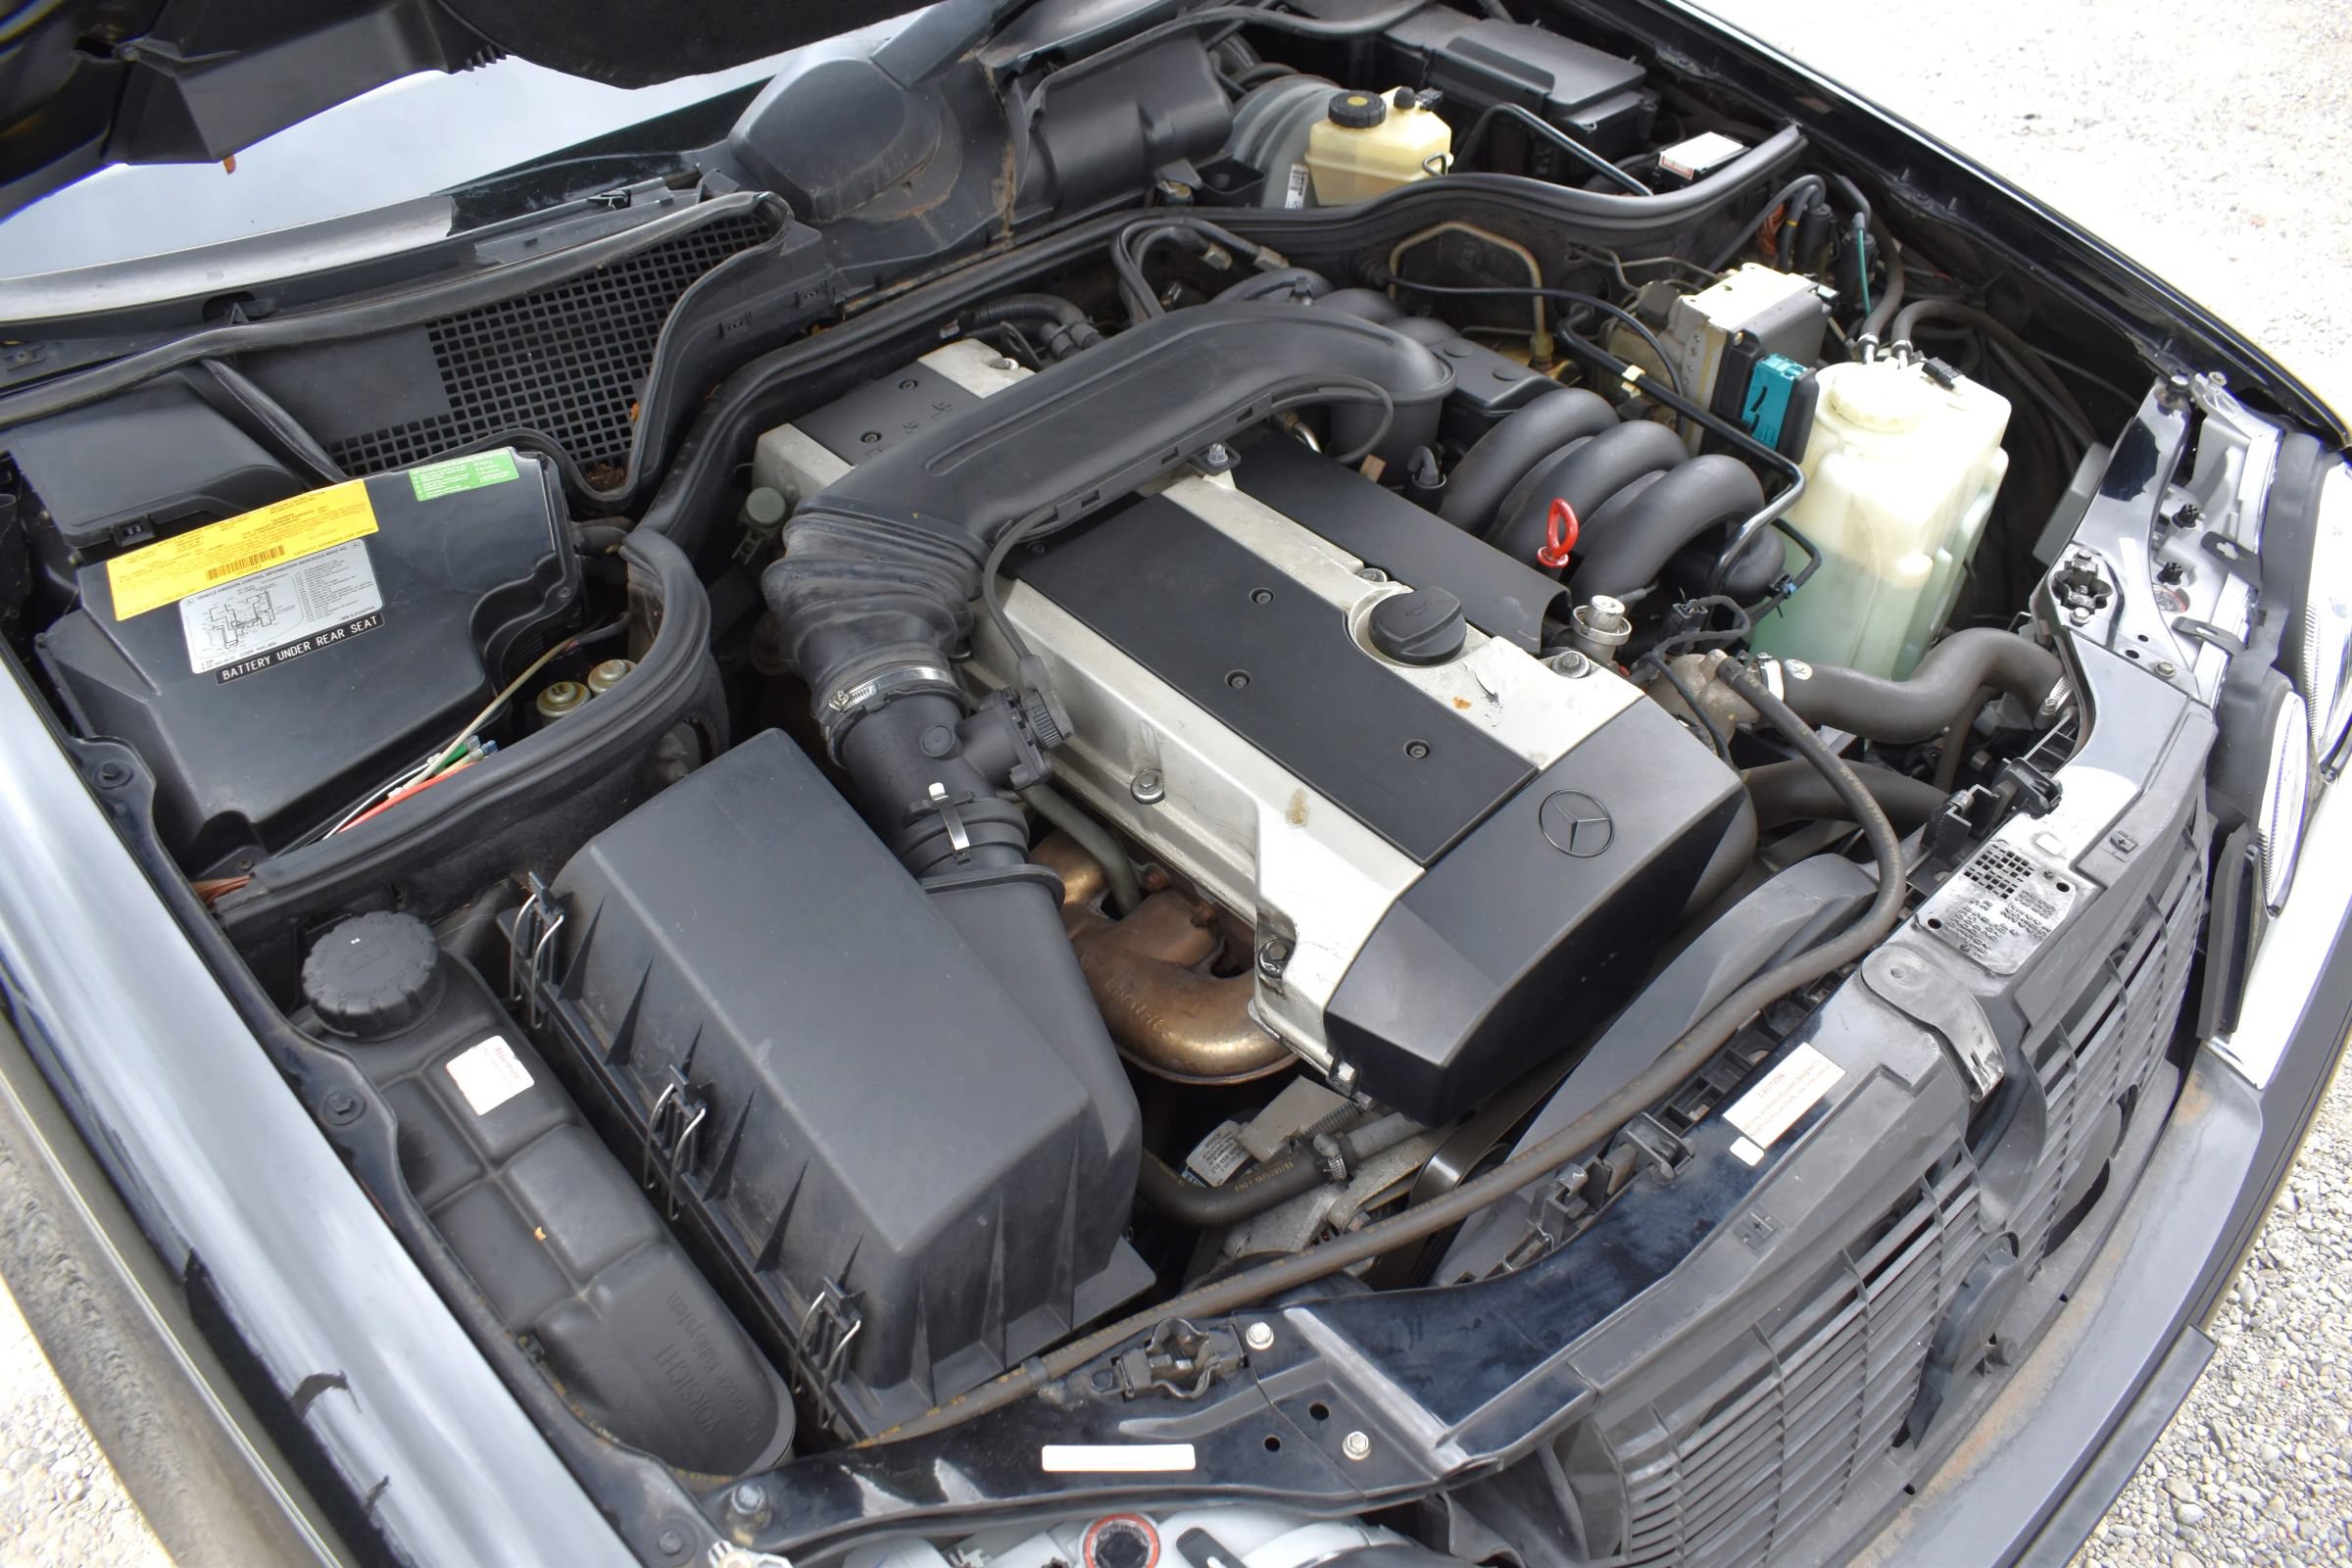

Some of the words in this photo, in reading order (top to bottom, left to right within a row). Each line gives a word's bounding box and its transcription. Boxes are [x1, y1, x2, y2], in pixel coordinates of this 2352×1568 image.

[222, 657, 270, 681] BATTERY
[276, 642, 311, 662] UNDER
[317, 629, 345, 647] REAR
[351, 617, 378, 634] SEAT
[1757, 1072, 1786, 1098] CAUTION
[655, 1343, 721, 1437] VORSICHT
